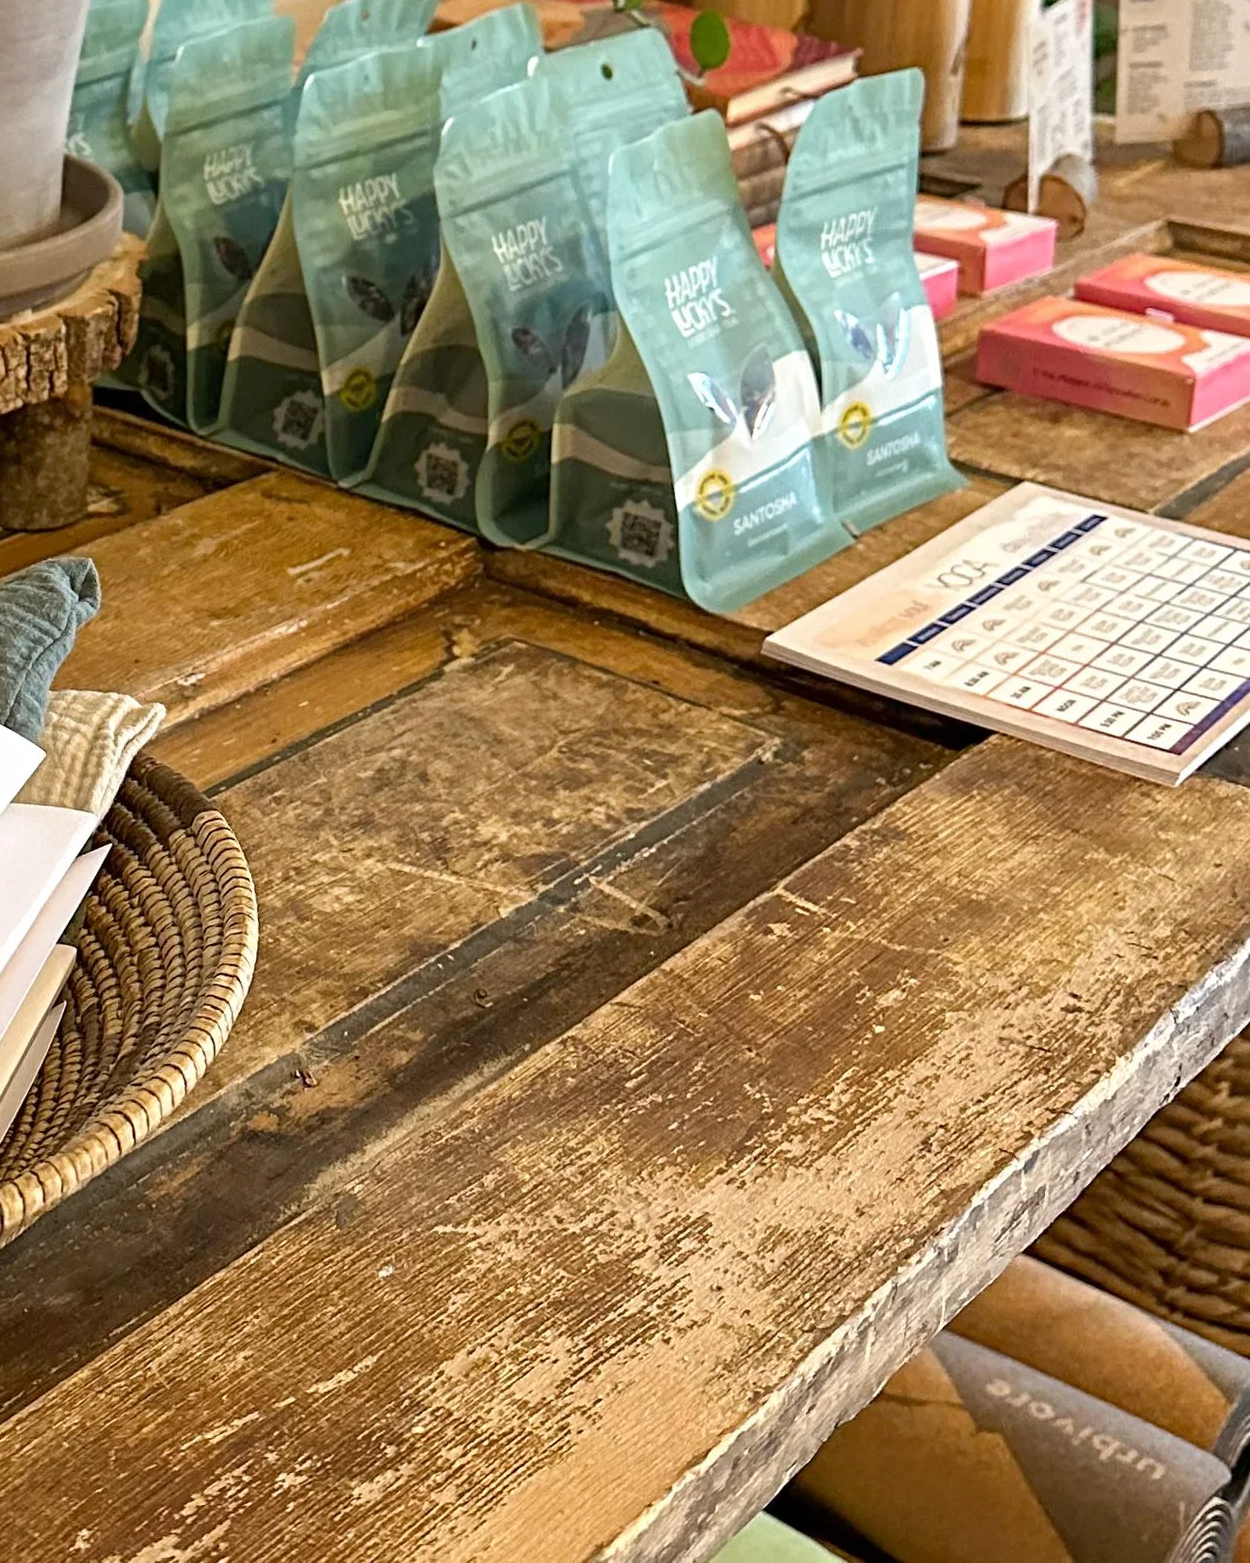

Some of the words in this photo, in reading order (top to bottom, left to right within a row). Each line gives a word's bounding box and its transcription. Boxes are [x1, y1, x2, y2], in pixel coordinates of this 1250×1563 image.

[204, 141, 255, 180] HAPPY
[338, 171, 401, 216] HAPPY
[491, 214, 547, 265] HAPPY
[820, 204, 878, 250] HAPPY
[664, 255, 718, 309] HAPPY
[733, 490, 797, 536] SANTOSHA
[984, 1378, 1167, 1481] urbivore
